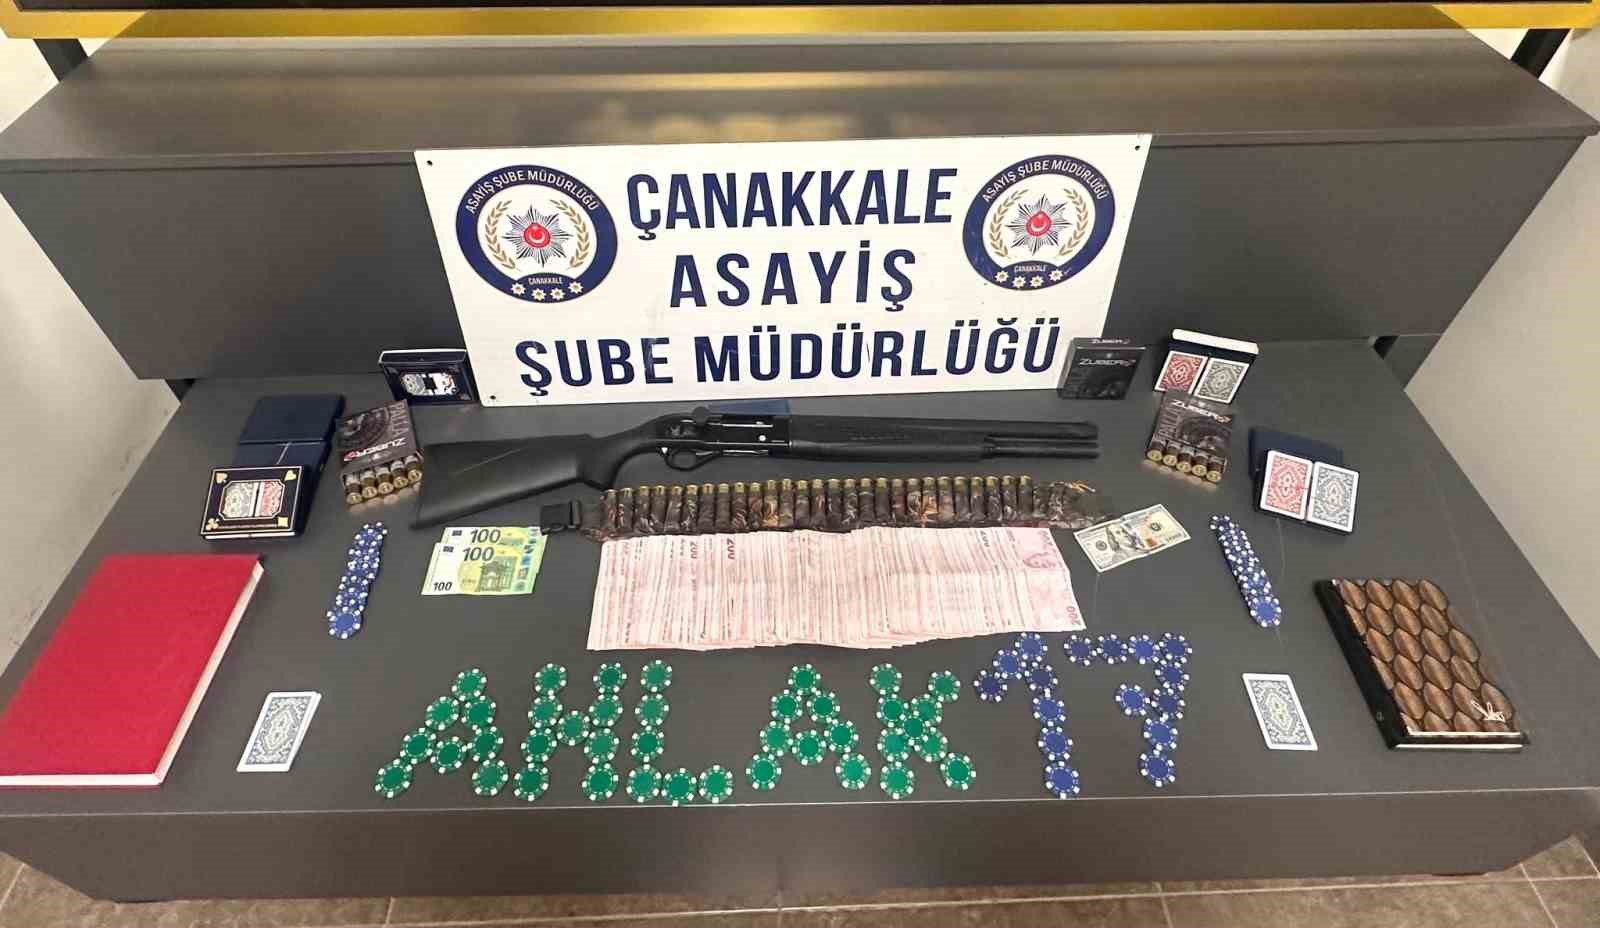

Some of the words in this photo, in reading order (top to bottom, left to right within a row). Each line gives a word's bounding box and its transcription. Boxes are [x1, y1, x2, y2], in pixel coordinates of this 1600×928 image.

[465, 180, 495, 214] ASAYİŞ
[491, 169, 526, 189] ŞUBE
[527, 168, 600, 211] MÜDÜRLÜĞÜ
[982, 170, 1017, 203] ASAYİŞ
[1017, 159, 1050, 178] ŞUBE
[1051, 158, 1109, 200] MÜDÜRLÜĞÜ
[626, 168, 958, 240] ÇANAKKALE
[669, 240, 916, 312] ASAYİŞ
[515, 337, 674, 397] ŞUBE
[694, 317, 1061, 384] MÜDÜRLÜĞÜ
[462, 546, 495, 562] 100
[470, 528, 501, 544] 100
[433, 581, 453, 592] 100
